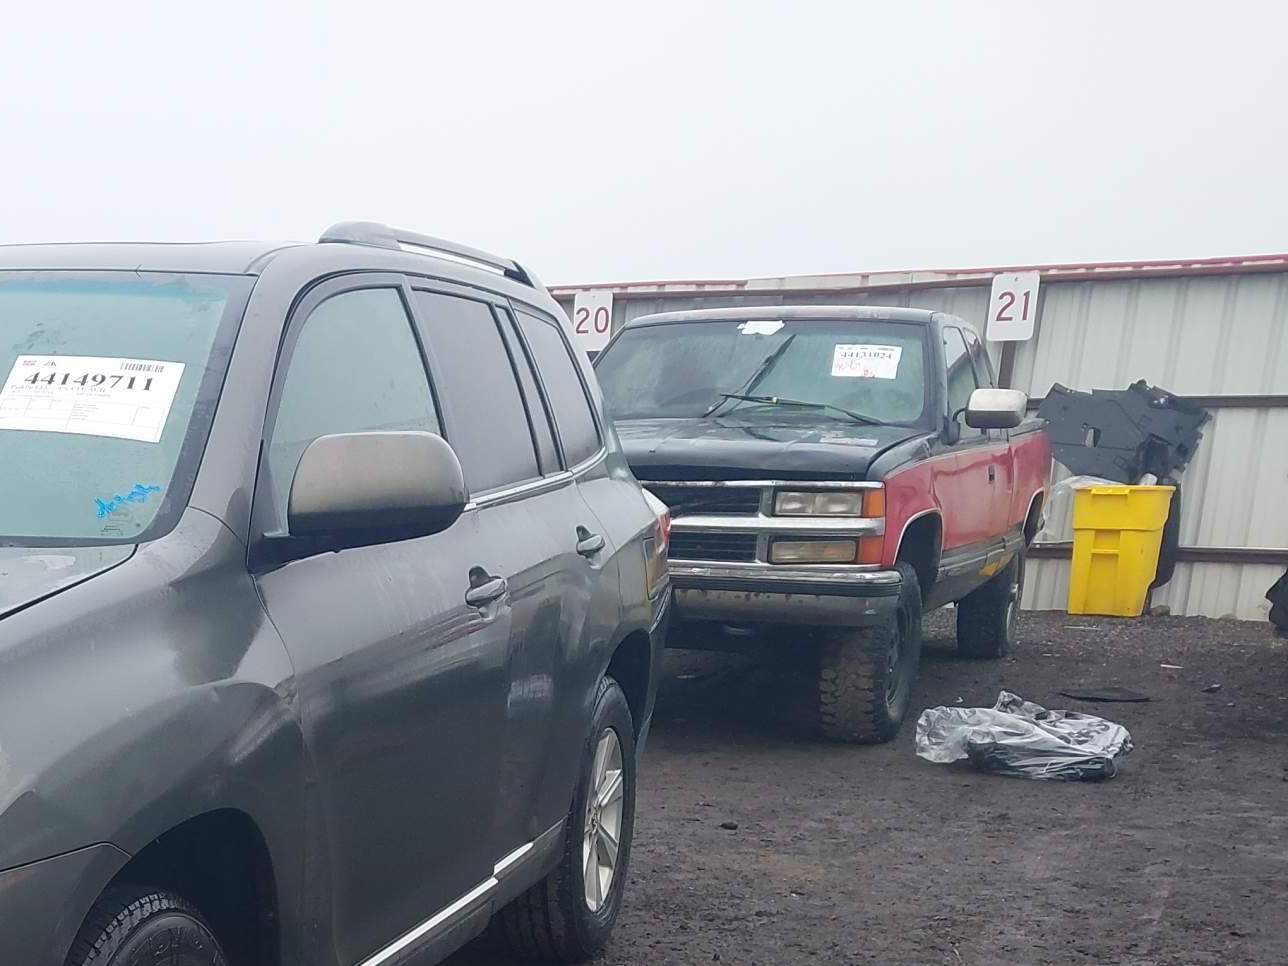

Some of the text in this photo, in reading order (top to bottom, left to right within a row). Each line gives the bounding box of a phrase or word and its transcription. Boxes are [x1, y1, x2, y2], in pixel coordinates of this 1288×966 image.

[576, 306, 609, 335] 20
[995, 290, 1030, 322] 21
[24, 371, 153, 391] 44149711
